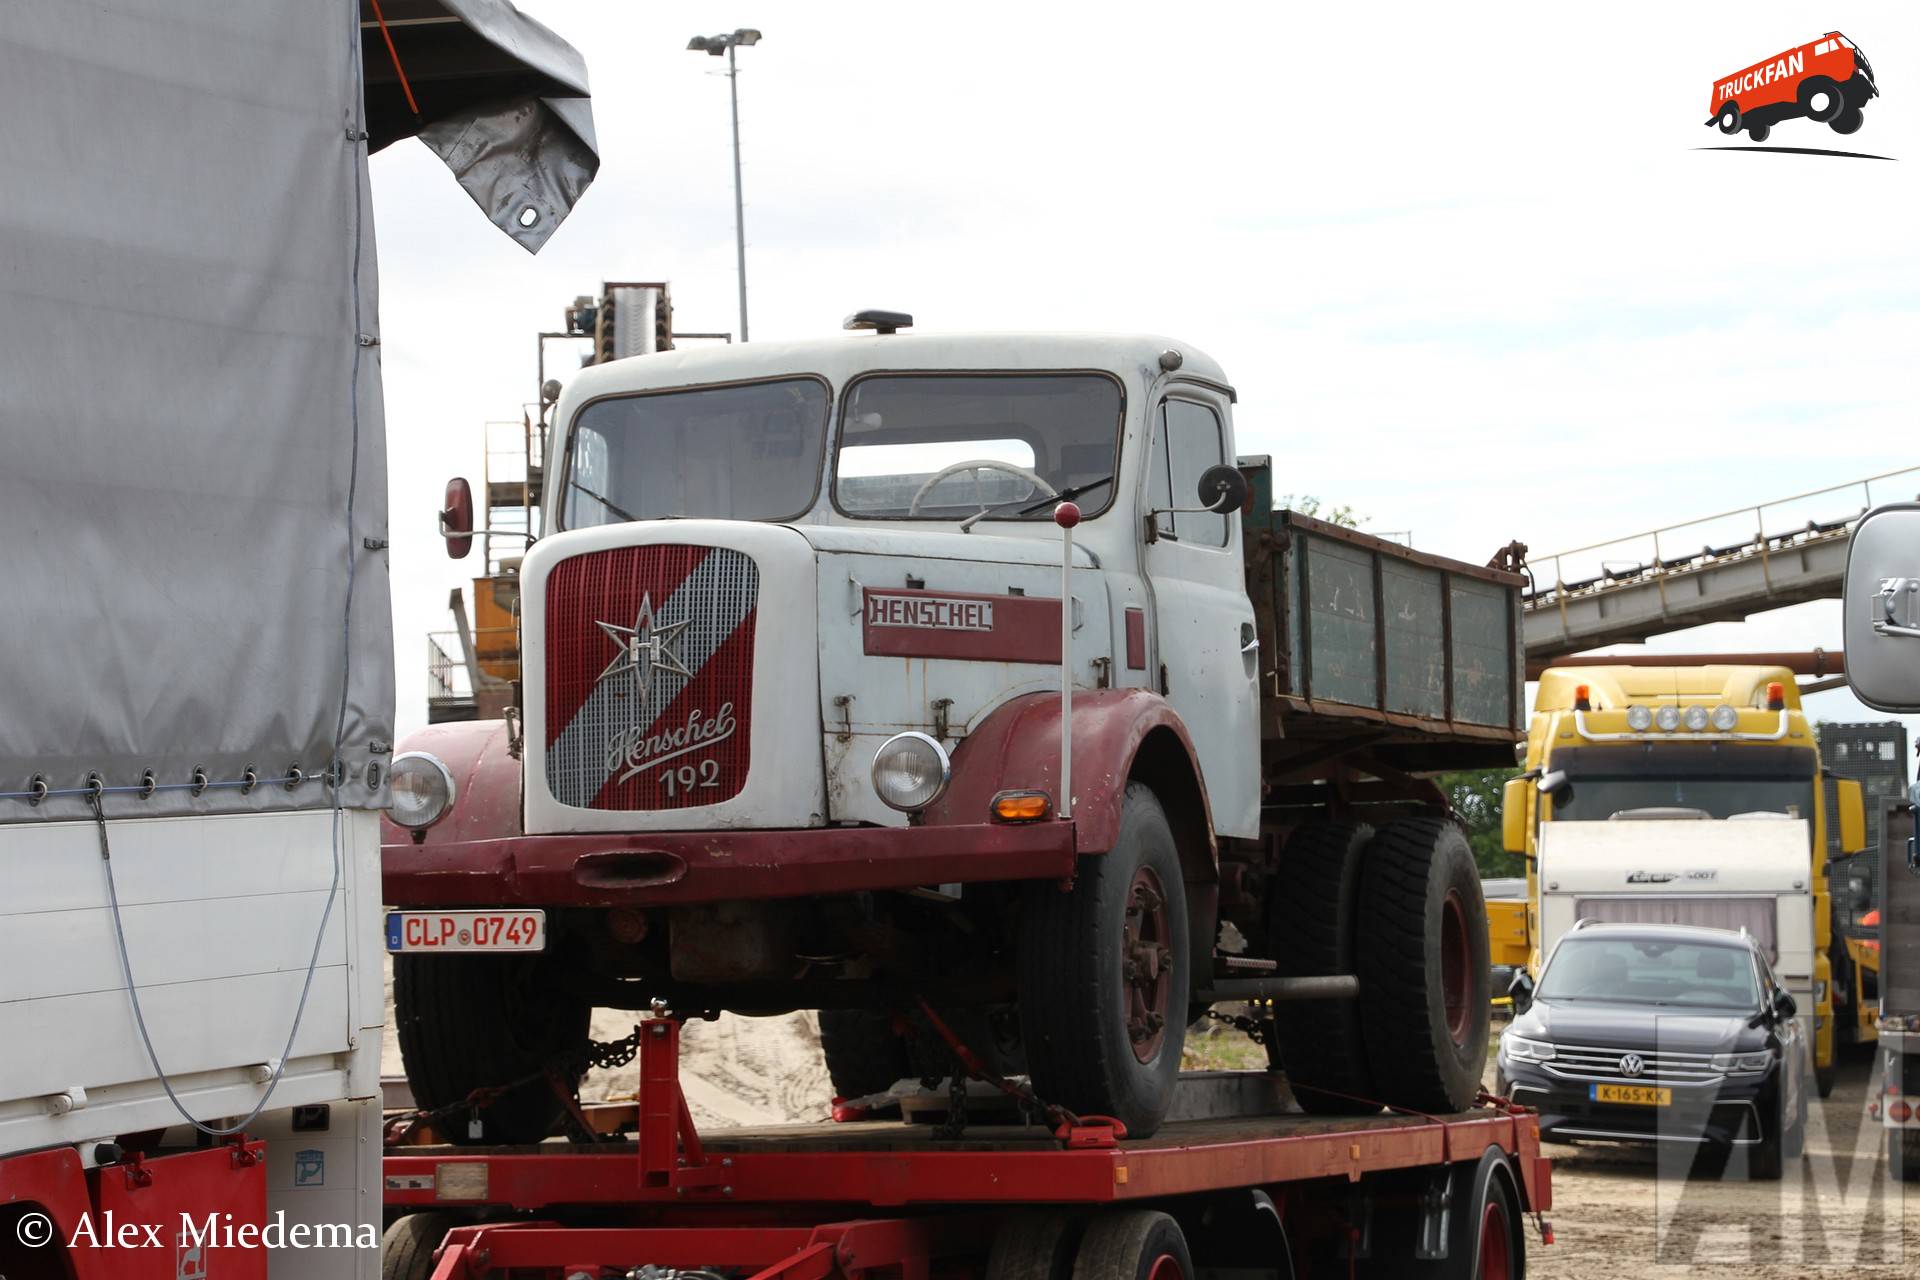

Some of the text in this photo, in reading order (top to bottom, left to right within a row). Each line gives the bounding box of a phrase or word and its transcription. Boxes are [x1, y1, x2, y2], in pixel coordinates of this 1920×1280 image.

[870, 598, 992, 629] HENSCHEL
[607, 702, 736, 784] Henschel
[658, 759, 720, 797] 192
[406, 917, 537, 946] CLP 0749
[1602, 1087, 1664, 1102] K-165-KK
